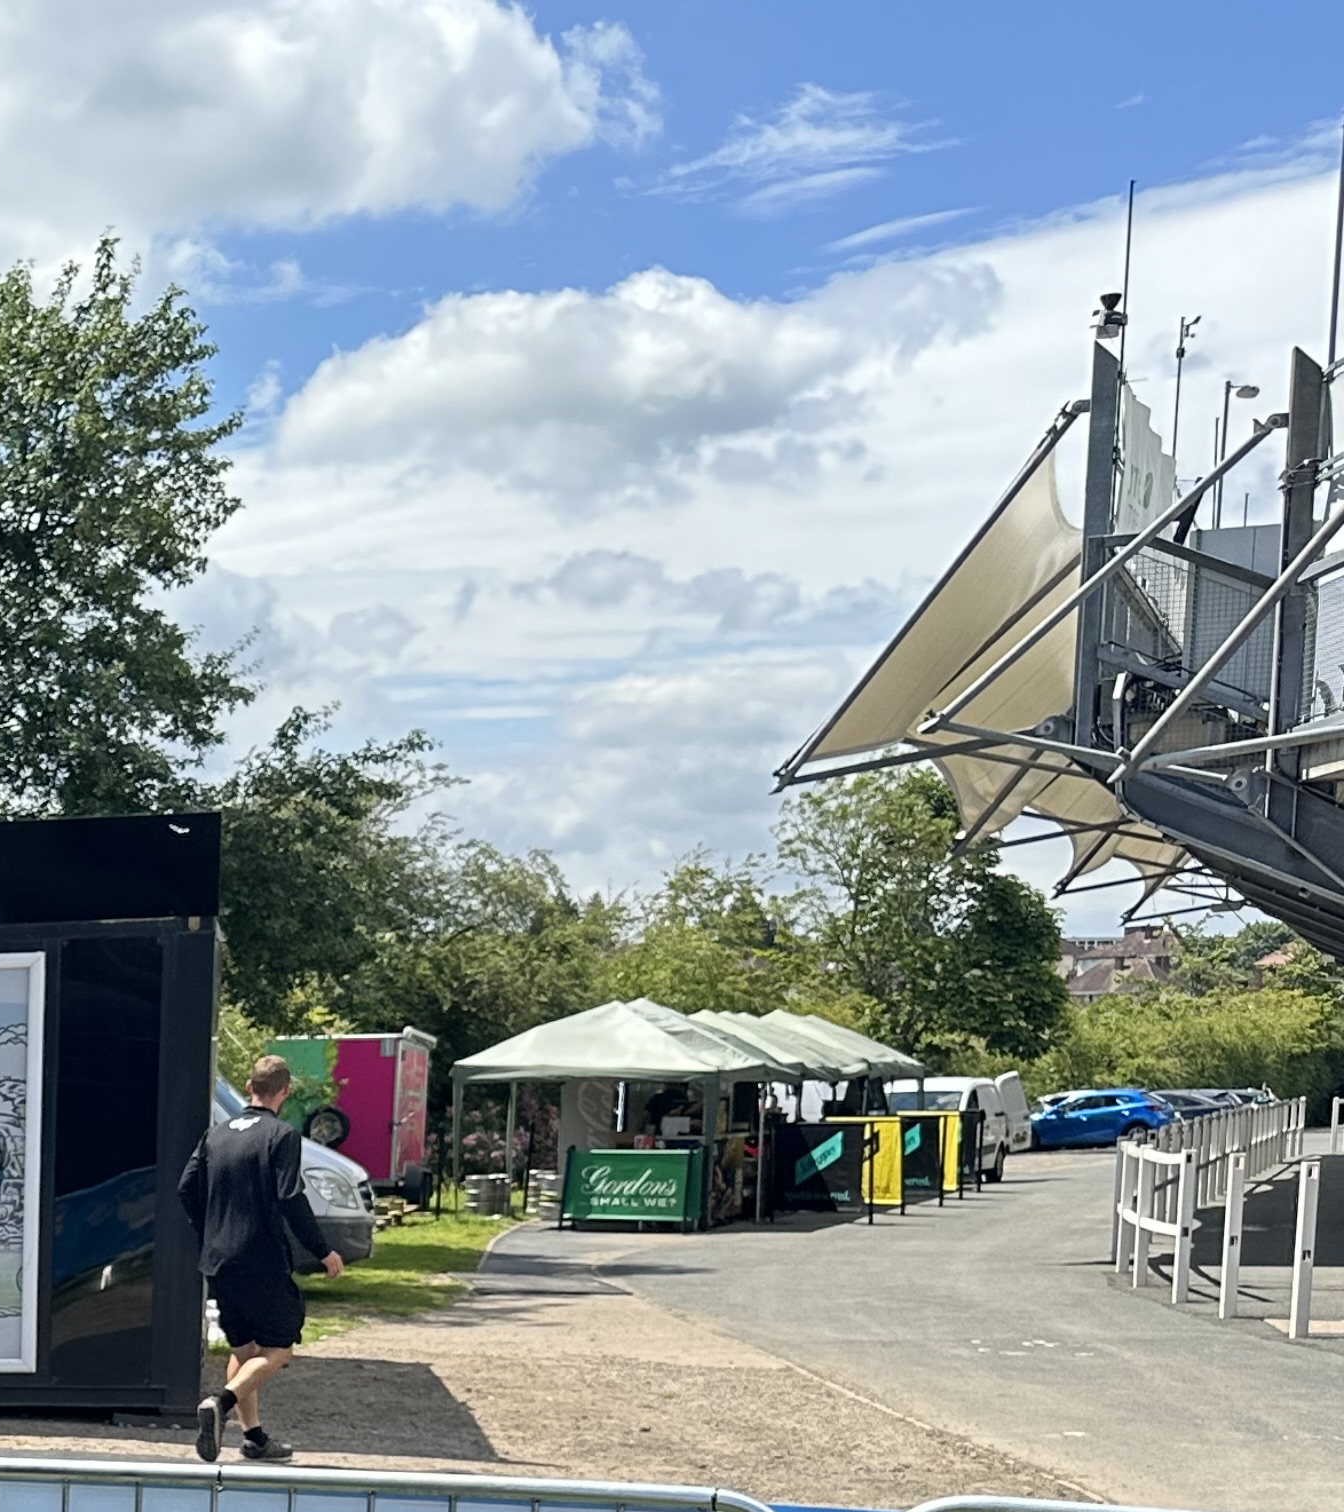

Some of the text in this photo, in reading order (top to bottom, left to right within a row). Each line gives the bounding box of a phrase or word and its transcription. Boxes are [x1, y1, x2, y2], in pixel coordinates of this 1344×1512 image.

[581, 1165, 677, 1196] Gordon's
[590, 1197, 677, 1208] SHALL WE?
